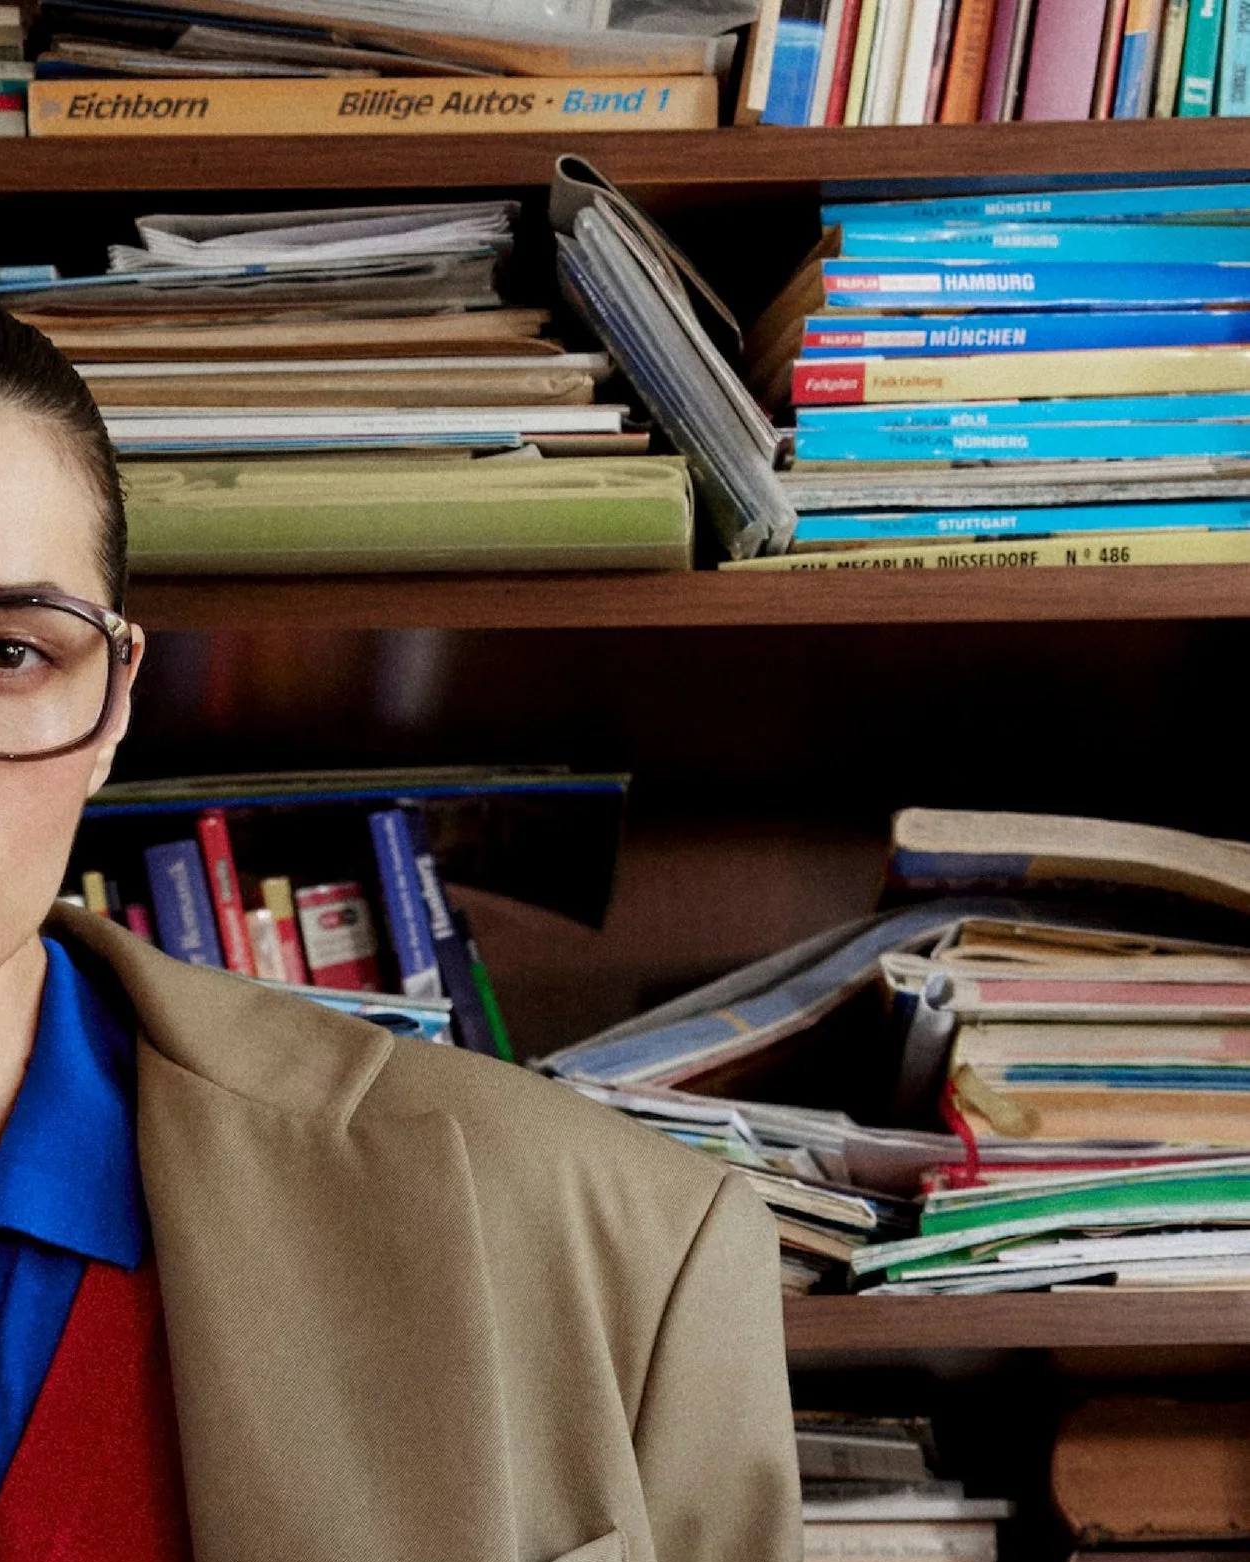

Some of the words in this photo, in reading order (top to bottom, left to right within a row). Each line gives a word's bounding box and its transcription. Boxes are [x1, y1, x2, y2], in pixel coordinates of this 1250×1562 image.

[66, 94, 209, 119] Eichborn
[338, 90, 434, 119] Billige
[440, 89, 534, 115] Autos
[562, 88, 645, 114] Band
[655, 87, 671, 113] 1
[984, 199, 1052, 216] MÜNSTER
[992, 233, 1060, 249] HAMBURG
[944, 273, 1036, 292] HAMBURG
[929, 326, 1027, 348] MÜNCHEN
[804, 376, 859, 393] Falkplan
[952, 432, 1030, 449] NÜRNBERG
[936, 515, 1018, 531] STUTTGART
[938, 550, 1039, 569] DÜSSELDORF
[1099, 546, 1131, 564] 486
